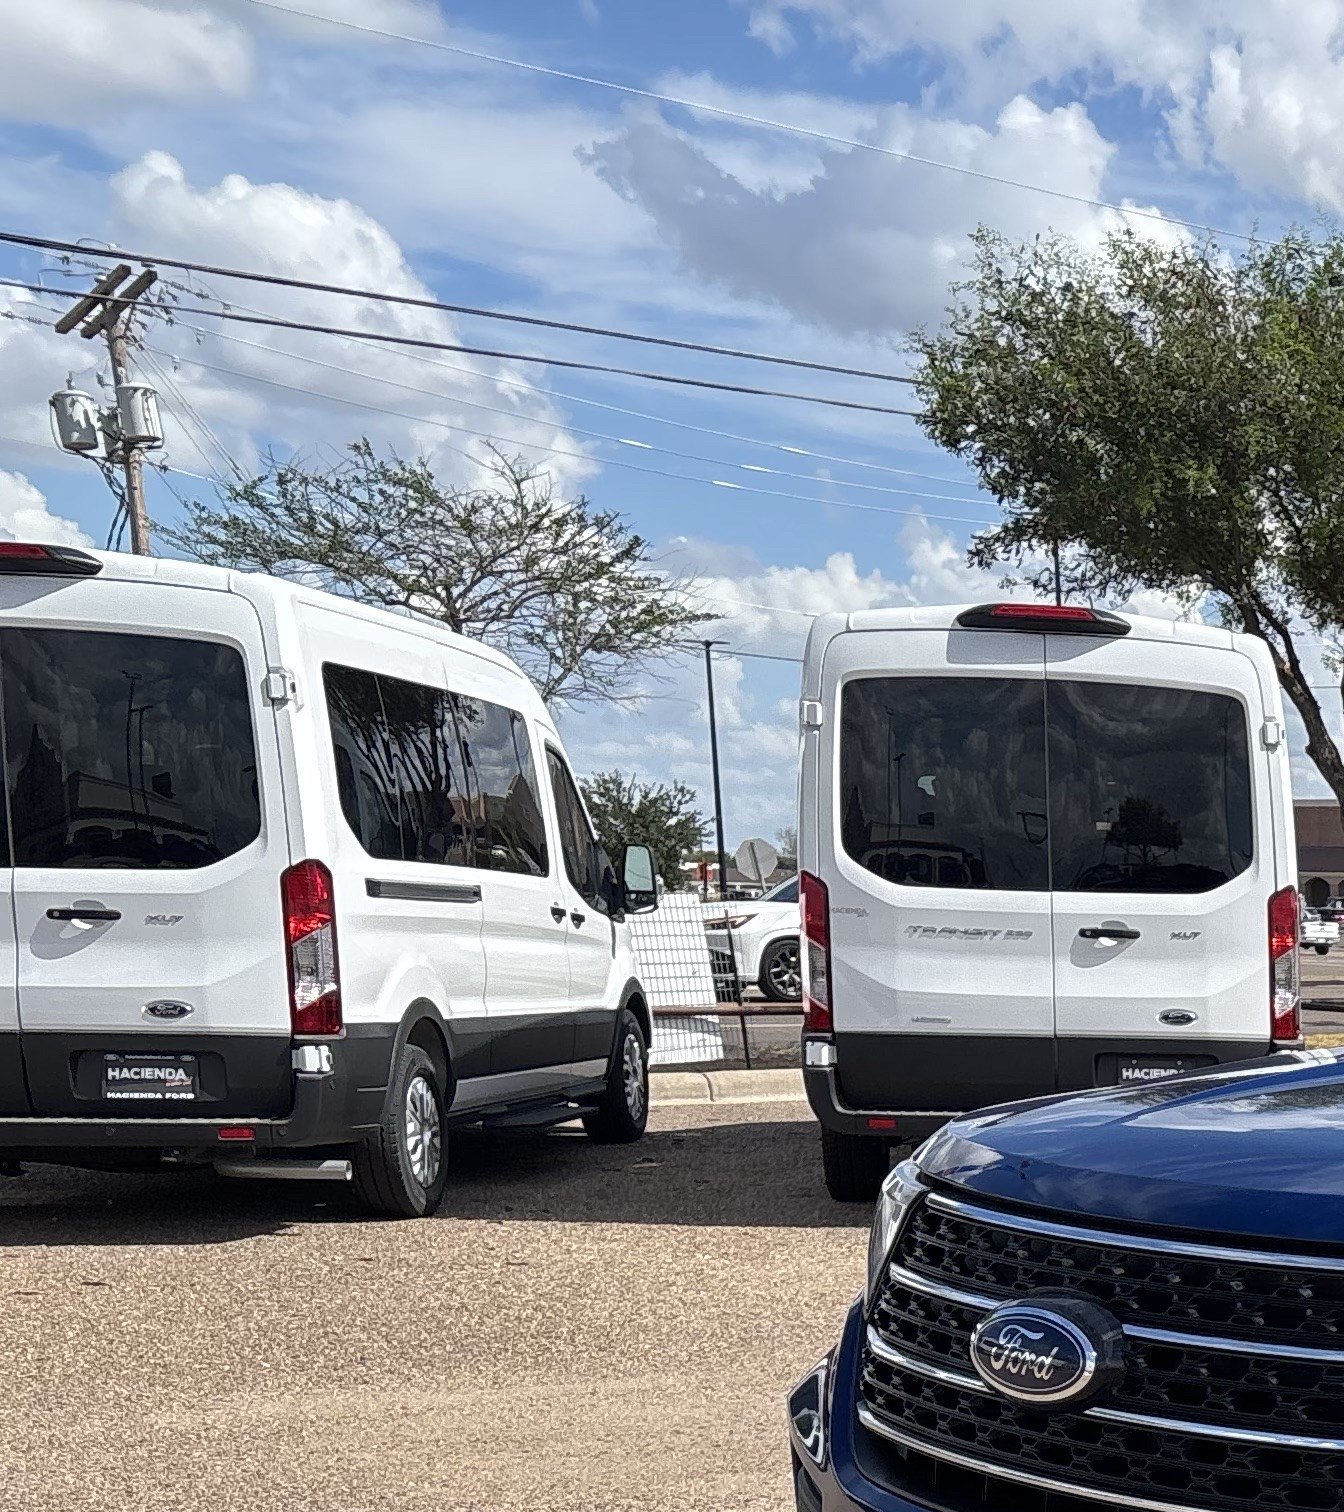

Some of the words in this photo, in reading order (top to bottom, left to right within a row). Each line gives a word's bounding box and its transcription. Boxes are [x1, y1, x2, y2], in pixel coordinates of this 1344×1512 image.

[107, 1067, 186, 1081] HACIENDA
[1121, 1067, 1187, 1080] HACIEN
[991, 1324, 1060, 1381] Ford
